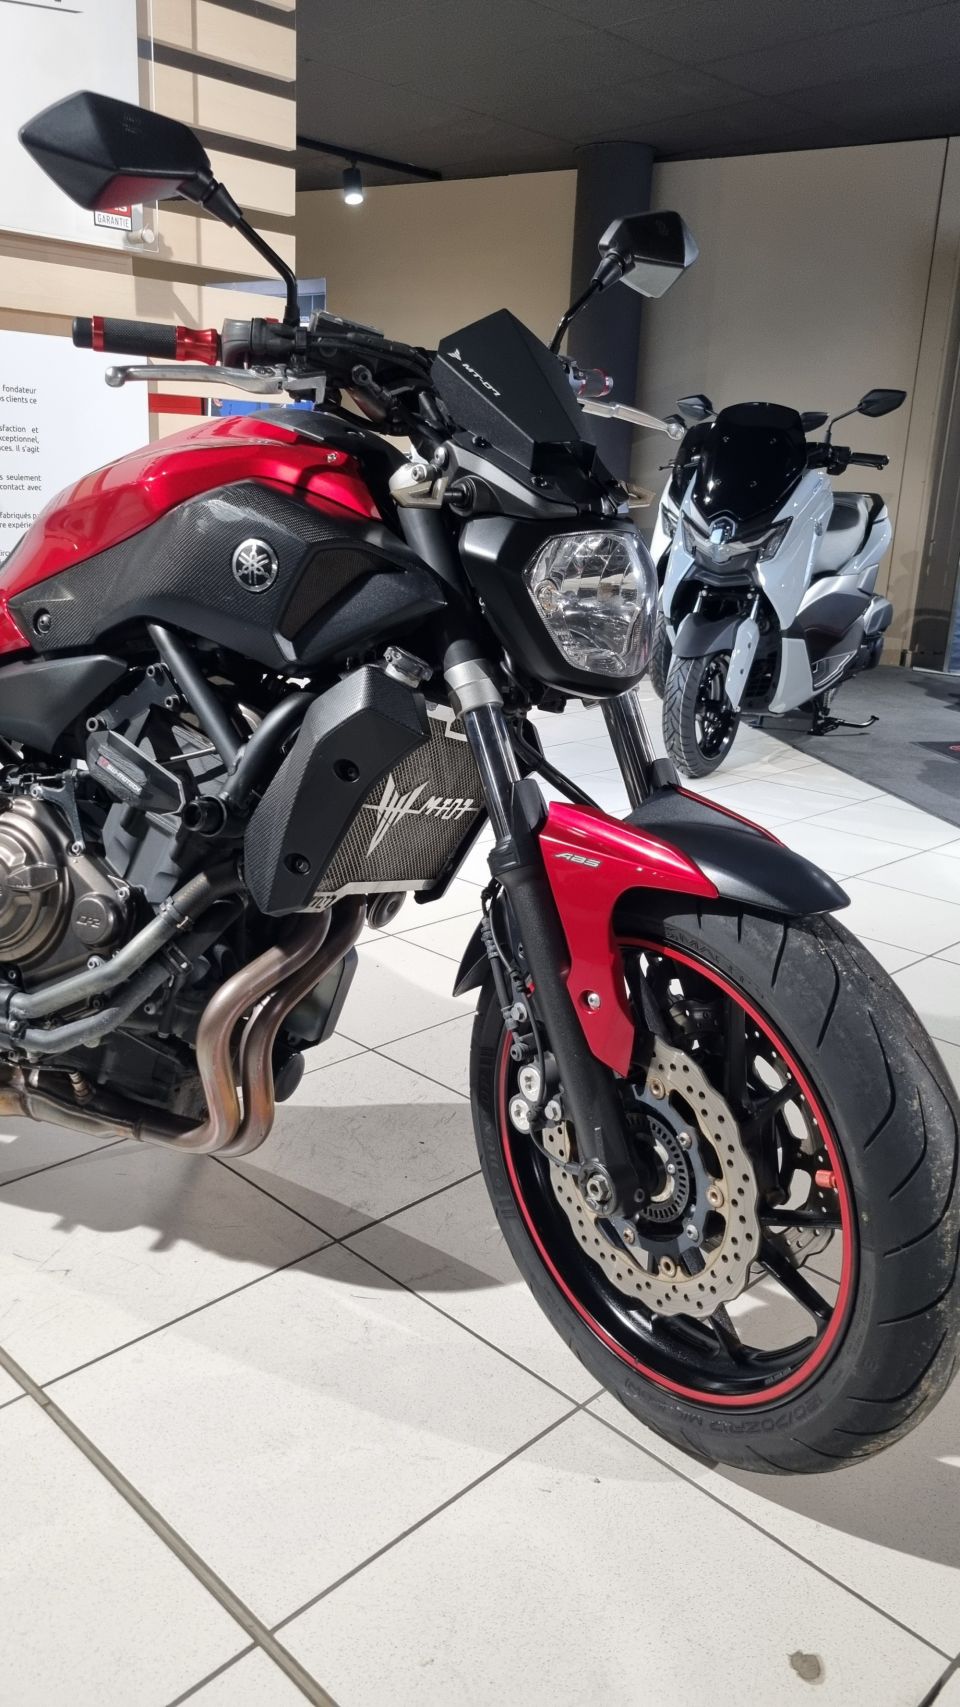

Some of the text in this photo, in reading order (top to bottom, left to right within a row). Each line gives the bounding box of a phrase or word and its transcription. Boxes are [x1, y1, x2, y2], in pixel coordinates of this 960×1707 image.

[97, 213, 129, 228] GARANTIE
[462, 363, 501, 397] MT-07
[2, 384, 37, 395] fondateur
[5, 395, 28, 404] clients
[6, 474, 42, 482] seulement
[0, 482, 25, 491] contact
[554, 852, 601, 868] ABS
